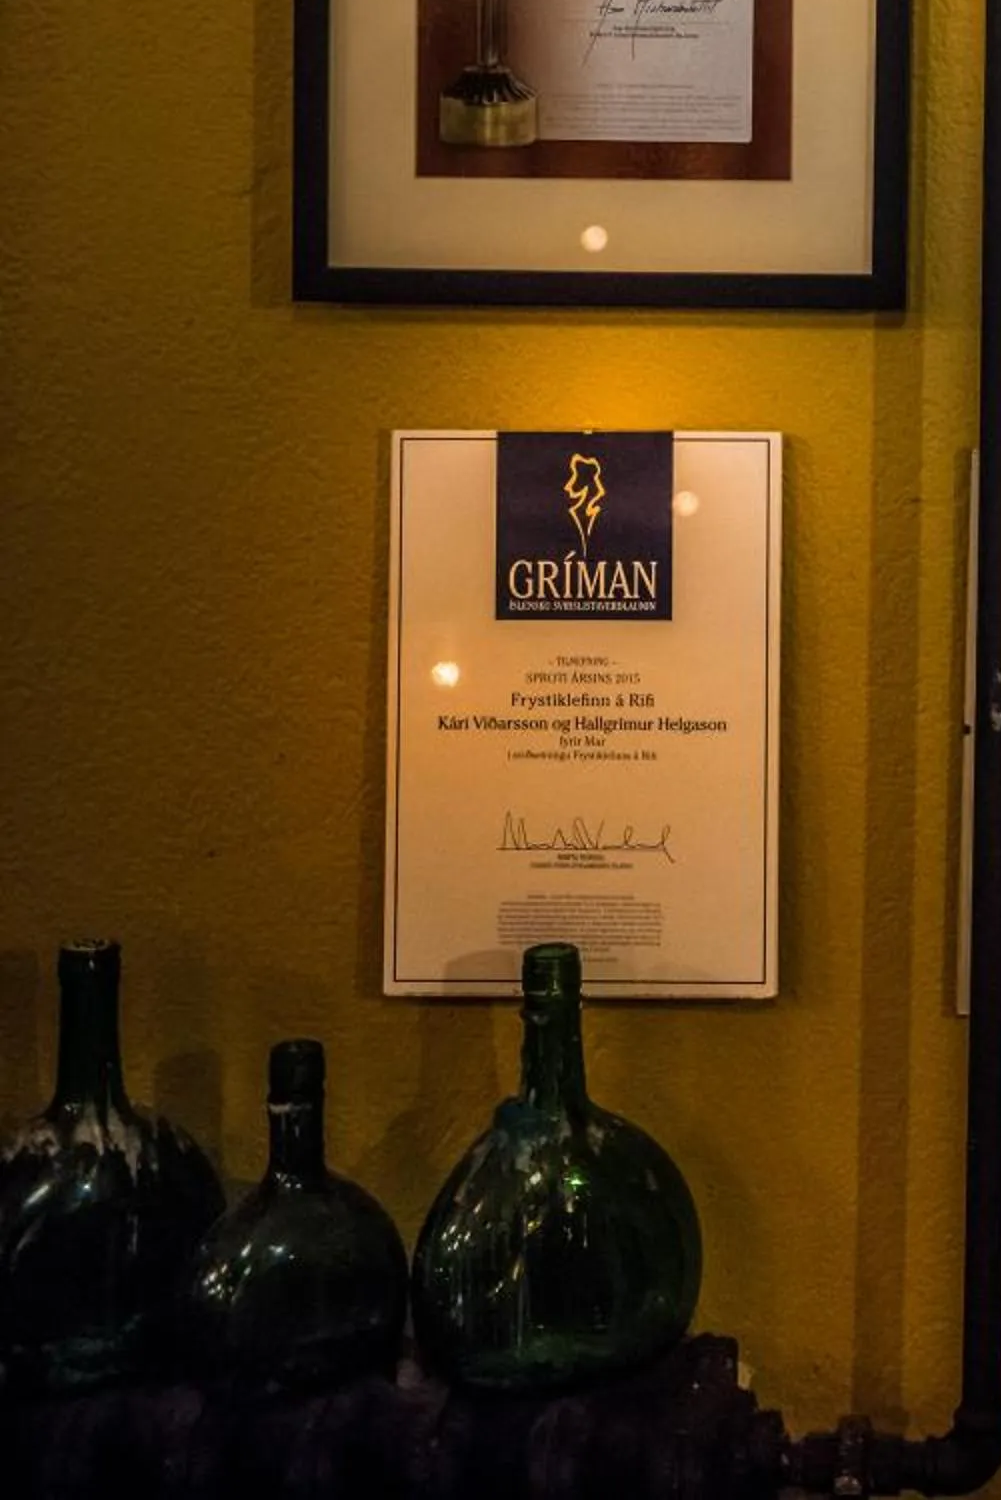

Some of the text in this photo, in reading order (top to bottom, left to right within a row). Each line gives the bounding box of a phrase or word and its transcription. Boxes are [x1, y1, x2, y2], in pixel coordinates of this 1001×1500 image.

[509, 551, 658, 599] GRÍMAN
[511, 692, 611, 710] Frystiklefinn
[629, 693, 655, 708] Rifi
[437, 716, 469, 730] Kári
[472, 716, 548, 731] Viðarsson
[552, 719, 571, 733] og
[657, 717, 728, 734] Helgason
[559, 735, 582, 748] fyrir
